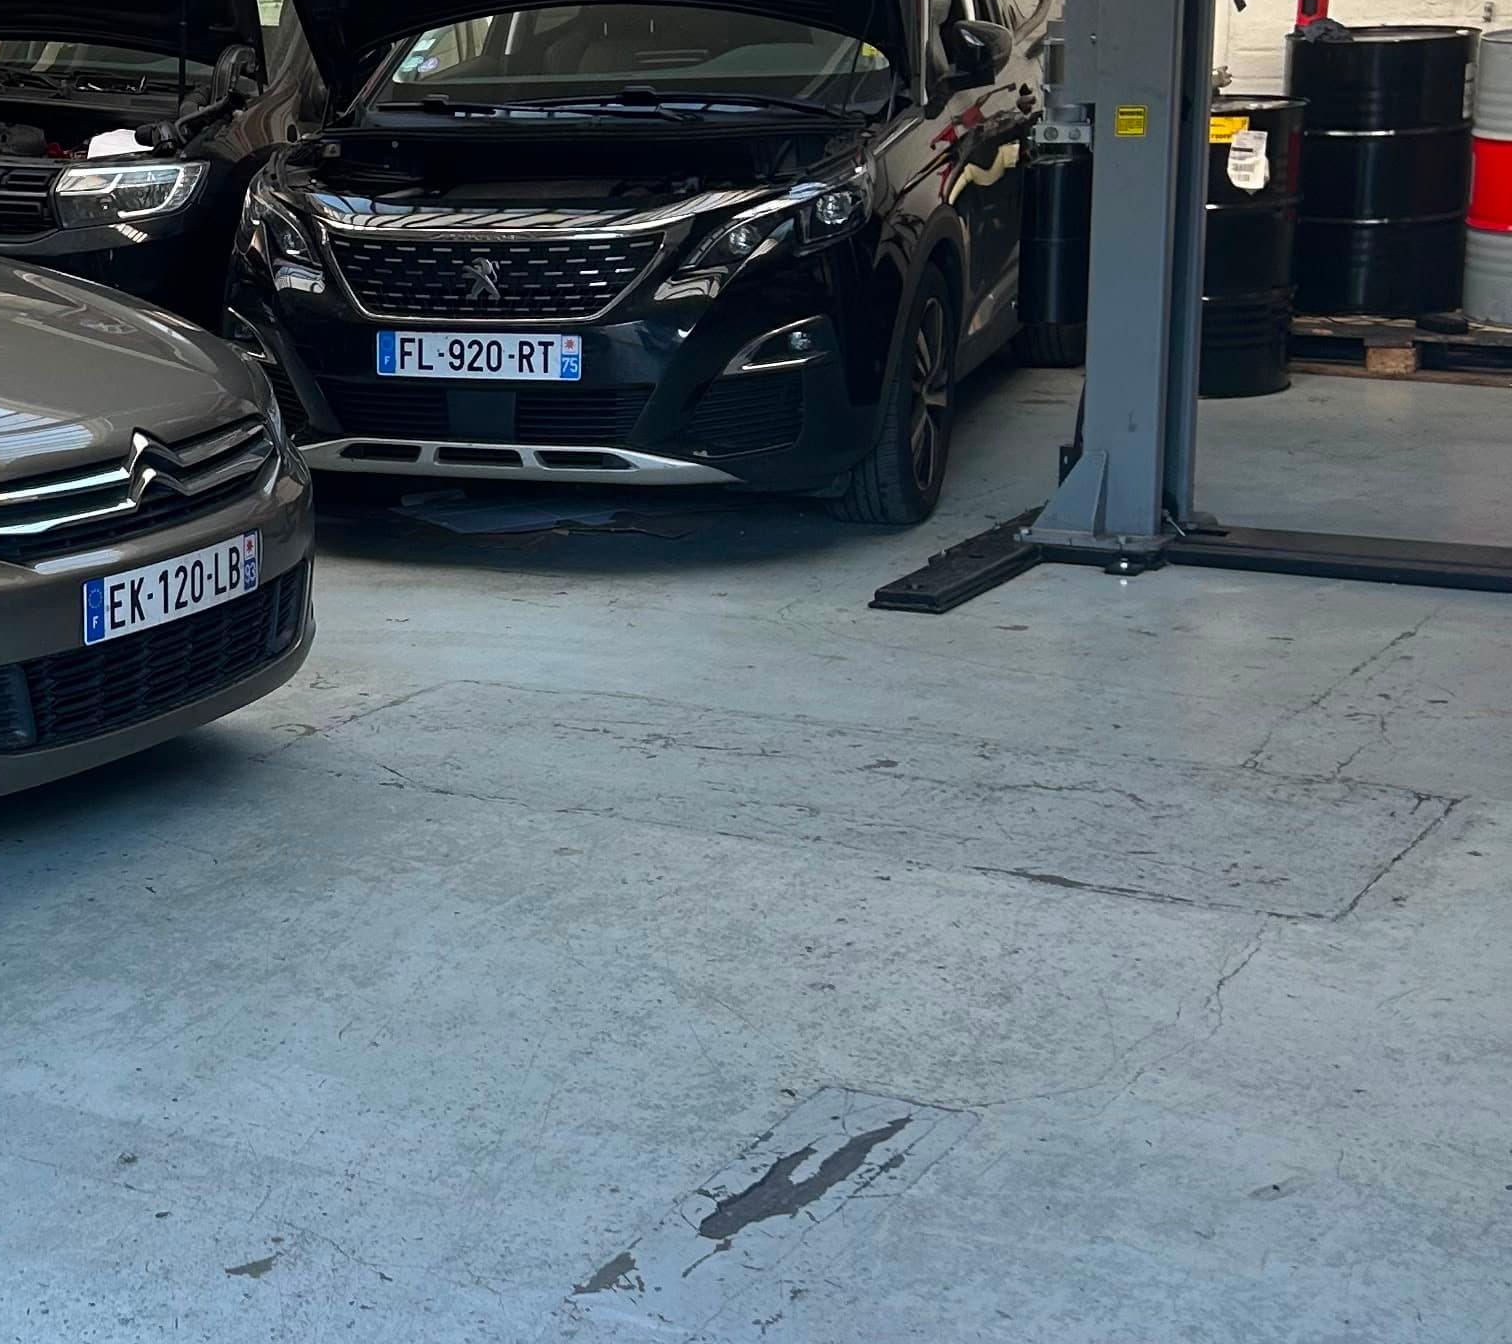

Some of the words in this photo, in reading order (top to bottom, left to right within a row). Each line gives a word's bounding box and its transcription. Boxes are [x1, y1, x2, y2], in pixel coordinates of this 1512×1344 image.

[384, 355, 391, 366] F
[399, 337, 555, 374] FL-920-RT
[561, 357, 579, 373] 75
[92, 615, 99, 630] F
[109, 546, 241, 630] EK-120-LB
[244, 558, 257, 584] 93
